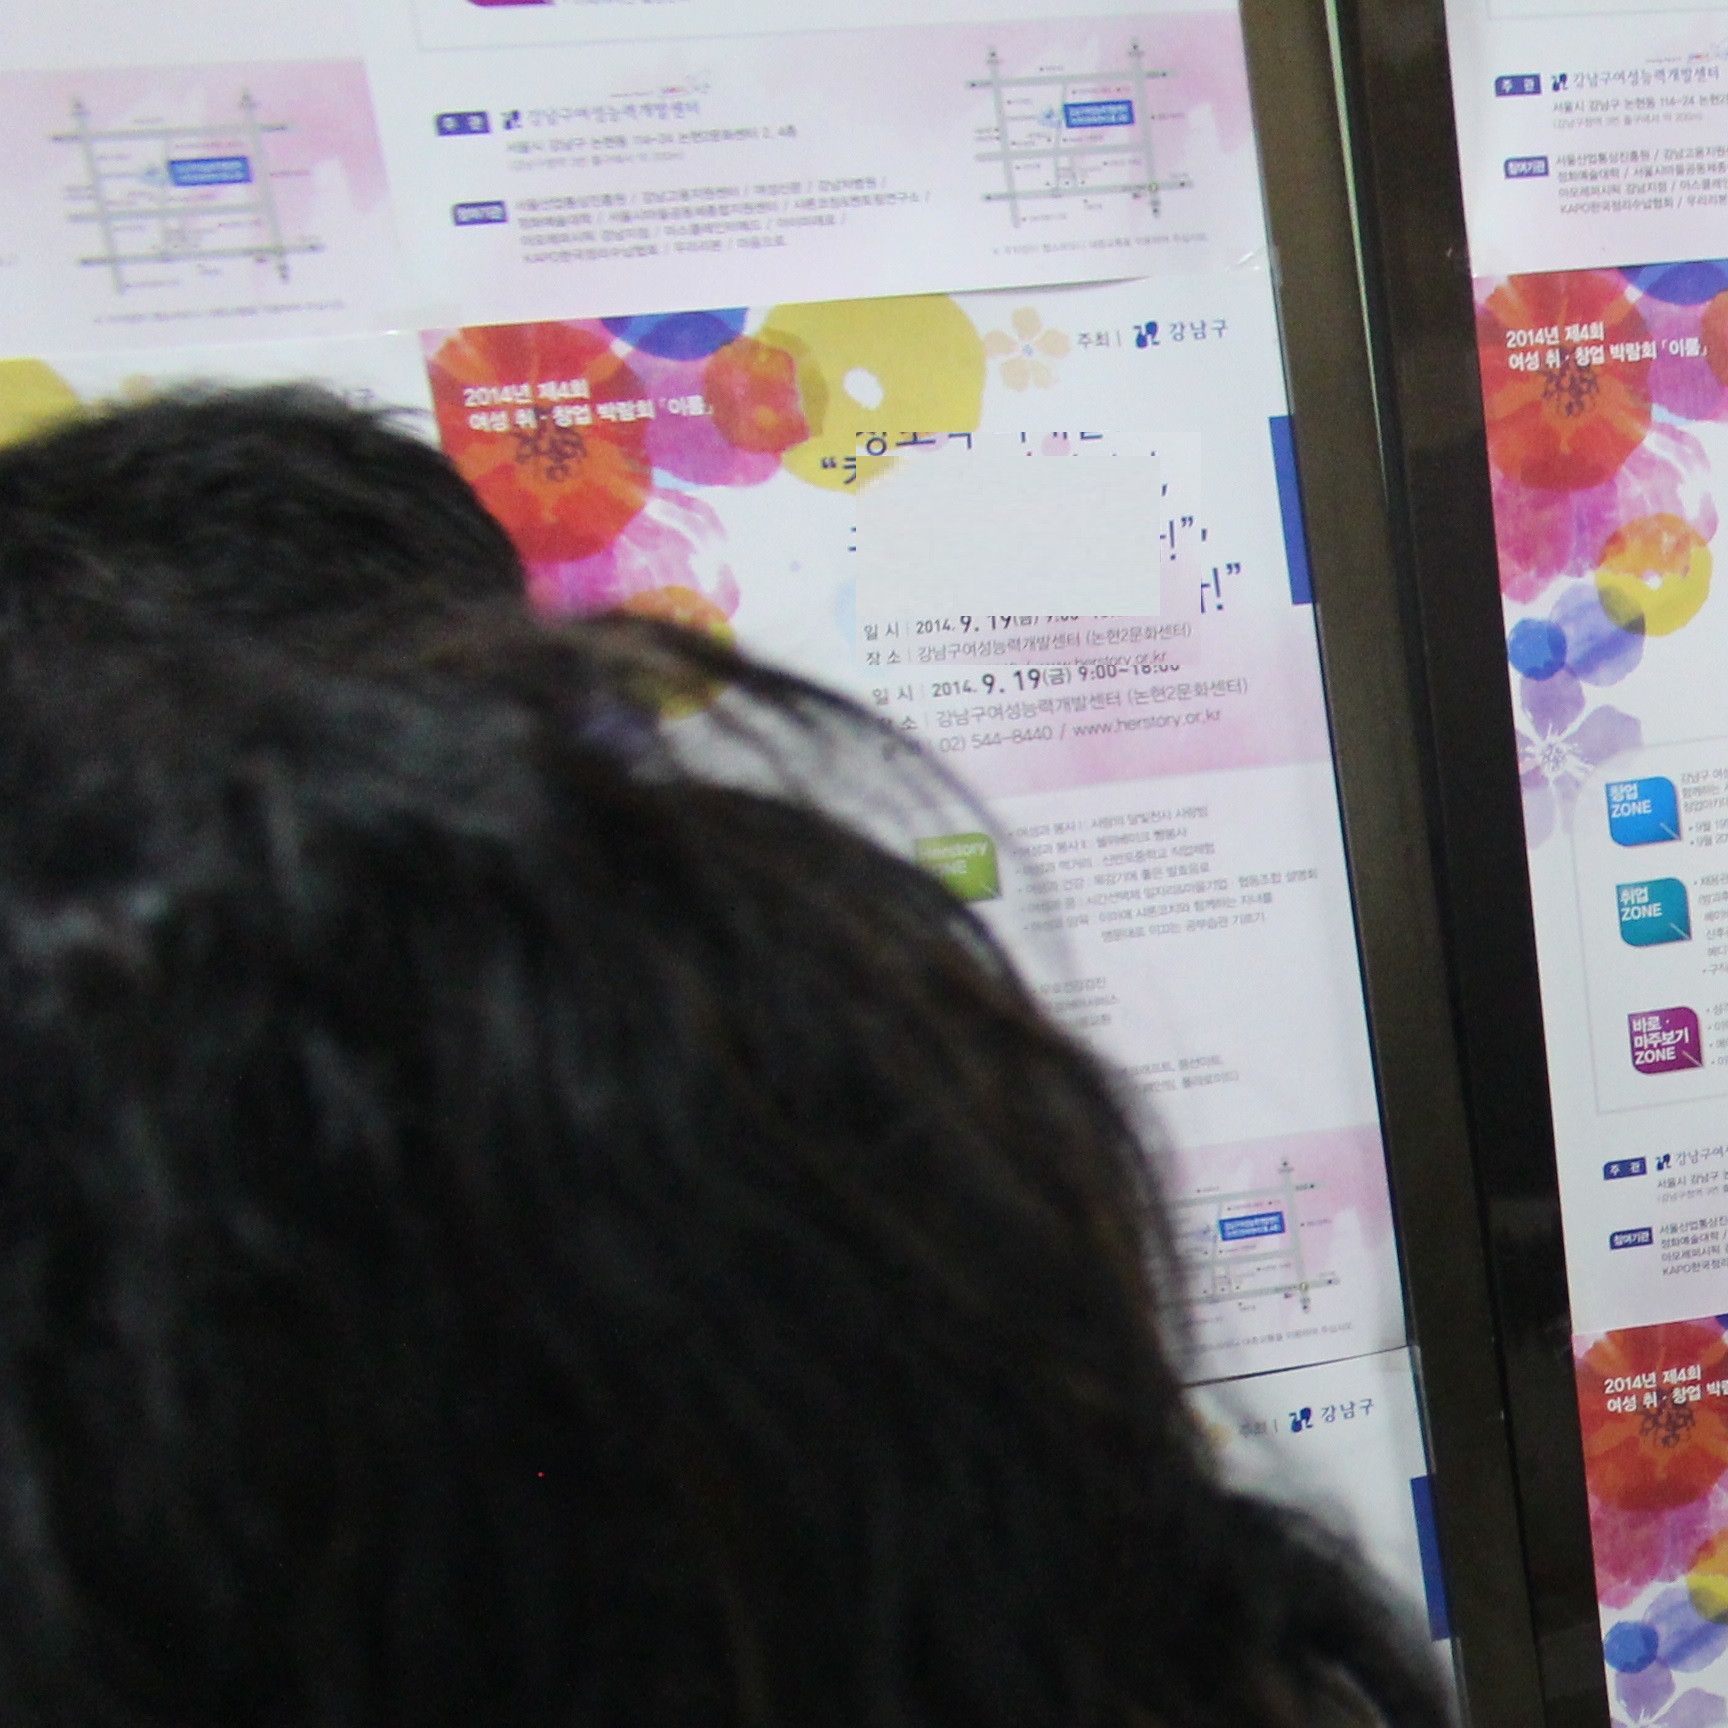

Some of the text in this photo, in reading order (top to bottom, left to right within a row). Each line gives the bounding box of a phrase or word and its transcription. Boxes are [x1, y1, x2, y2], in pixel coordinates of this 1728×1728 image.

[1169, 320, 1230, 342] 강남구
[1506, 321, 1604, 348] 2014년 제4회
[1509, 351, 1540, 372] 여성
[1546, 349, 1561, 369] 취
[1576, 345, 1605, 366] 창업
[1610, 341, 1657, 362] 박람회
[464, 383, 533, 407] 2014년
[1611, 783, 1638, 801] 창업
[1611, 800, 1652, 818] ZONE
[1620, 887, 1649, 904] 취업
[1621, 903, 1662, 922] ZONE
[1632, 1017, 1661, 1032] 바로
[1634, 1028, 1689, 1049] 마주보기
[1635, 1048, 1676, 1065] ZONE
[1605, 1365, 1701, 1394] 2014년 제4회
[1607, 1395, 1637, 1413] 여성
[1643, 1393, 1657, 1408] 취
[1673, 1384, 1700, 1404] 창업
[1321, 1399, 1374, 1423] 강남구
